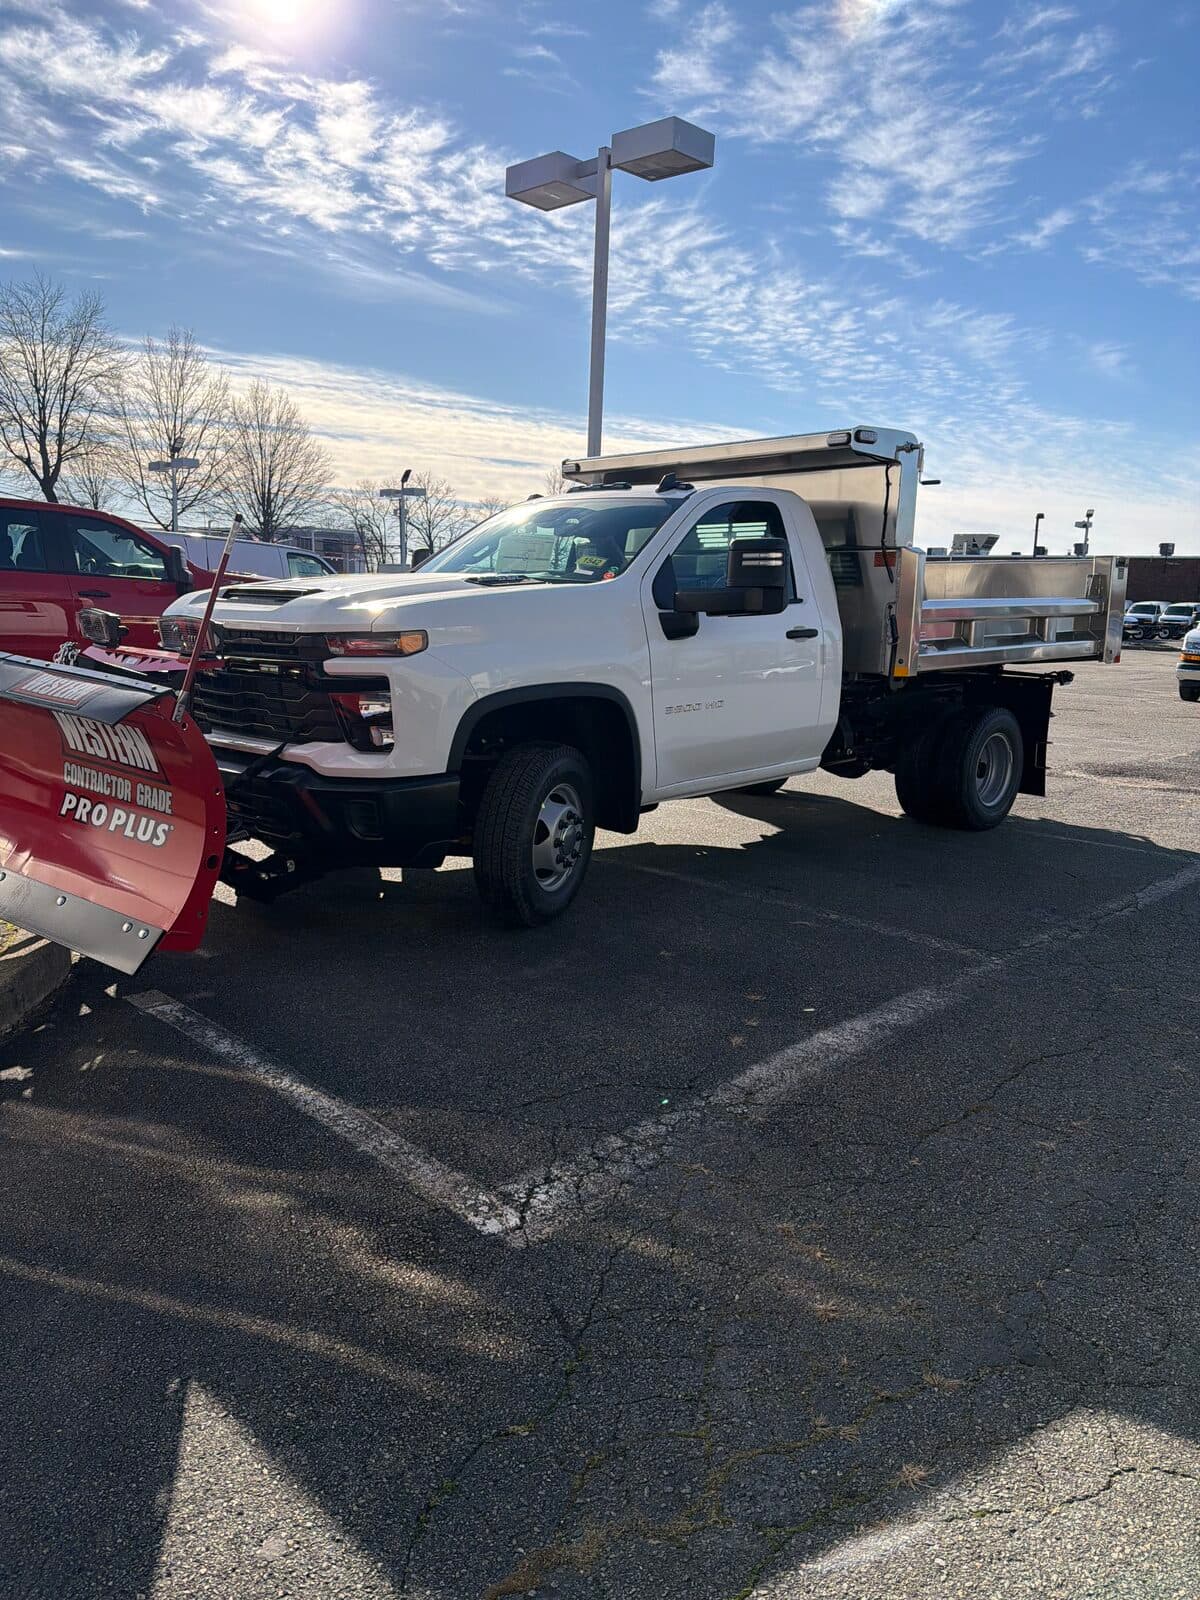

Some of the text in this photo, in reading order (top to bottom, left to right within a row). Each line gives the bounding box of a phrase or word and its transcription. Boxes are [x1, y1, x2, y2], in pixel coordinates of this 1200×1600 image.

[51, 710, 159, 773] WESTERN
[63, 761, 173, 814] CONTRACTOR GRADE
